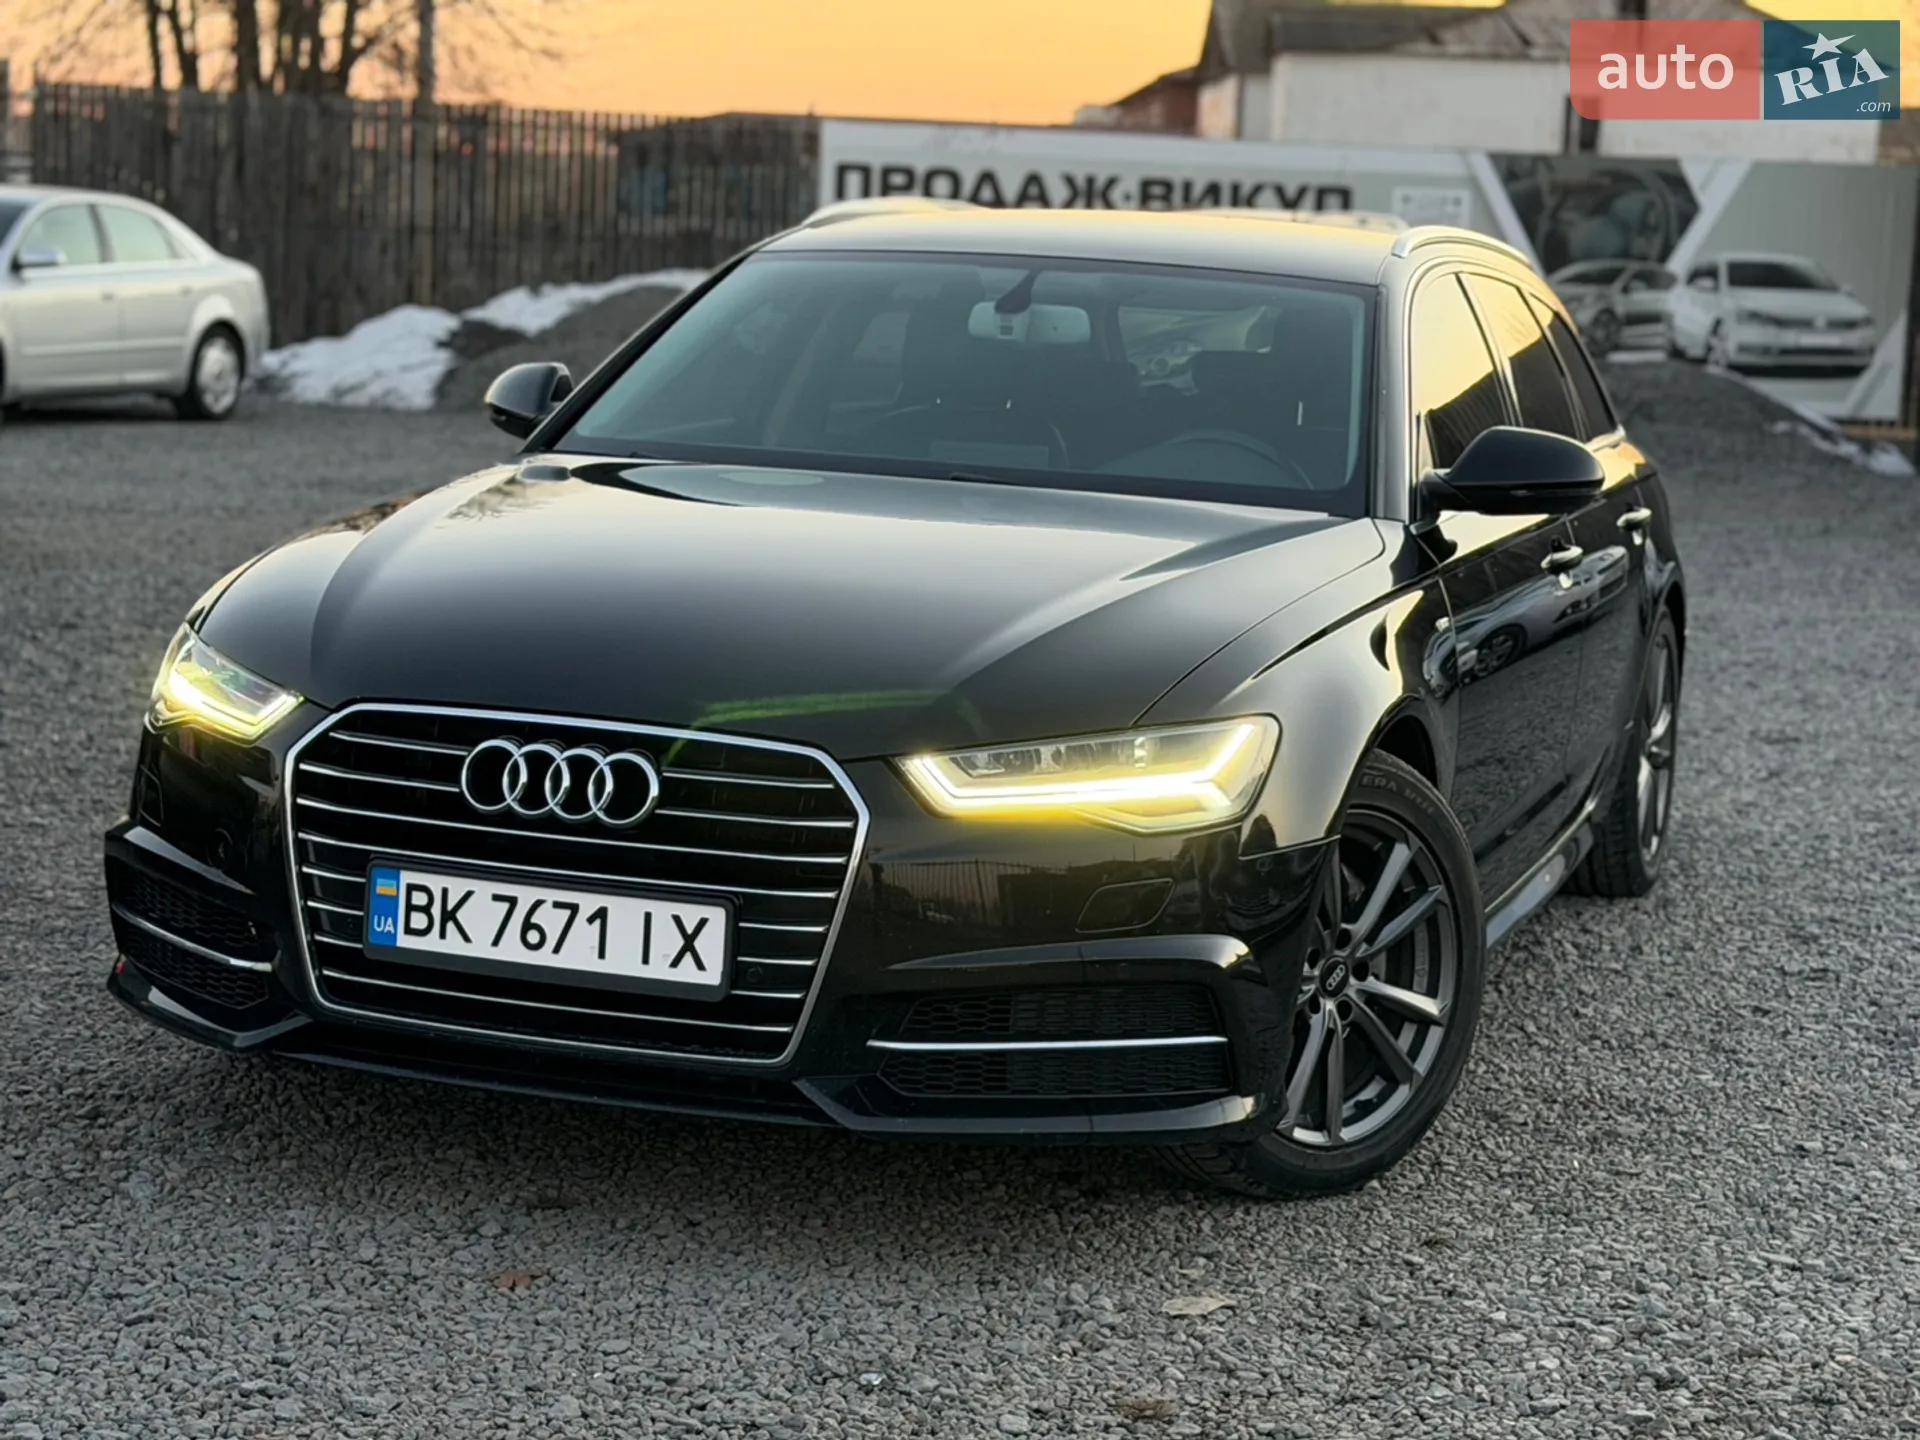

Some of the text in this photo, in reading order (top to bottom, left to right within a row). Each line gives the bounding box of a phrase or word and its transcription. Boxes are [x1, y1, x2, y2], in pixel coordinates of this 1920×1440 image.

[373, 914, 396, 935] UA
[403, 881, 711, 972] BK 7671 IX
